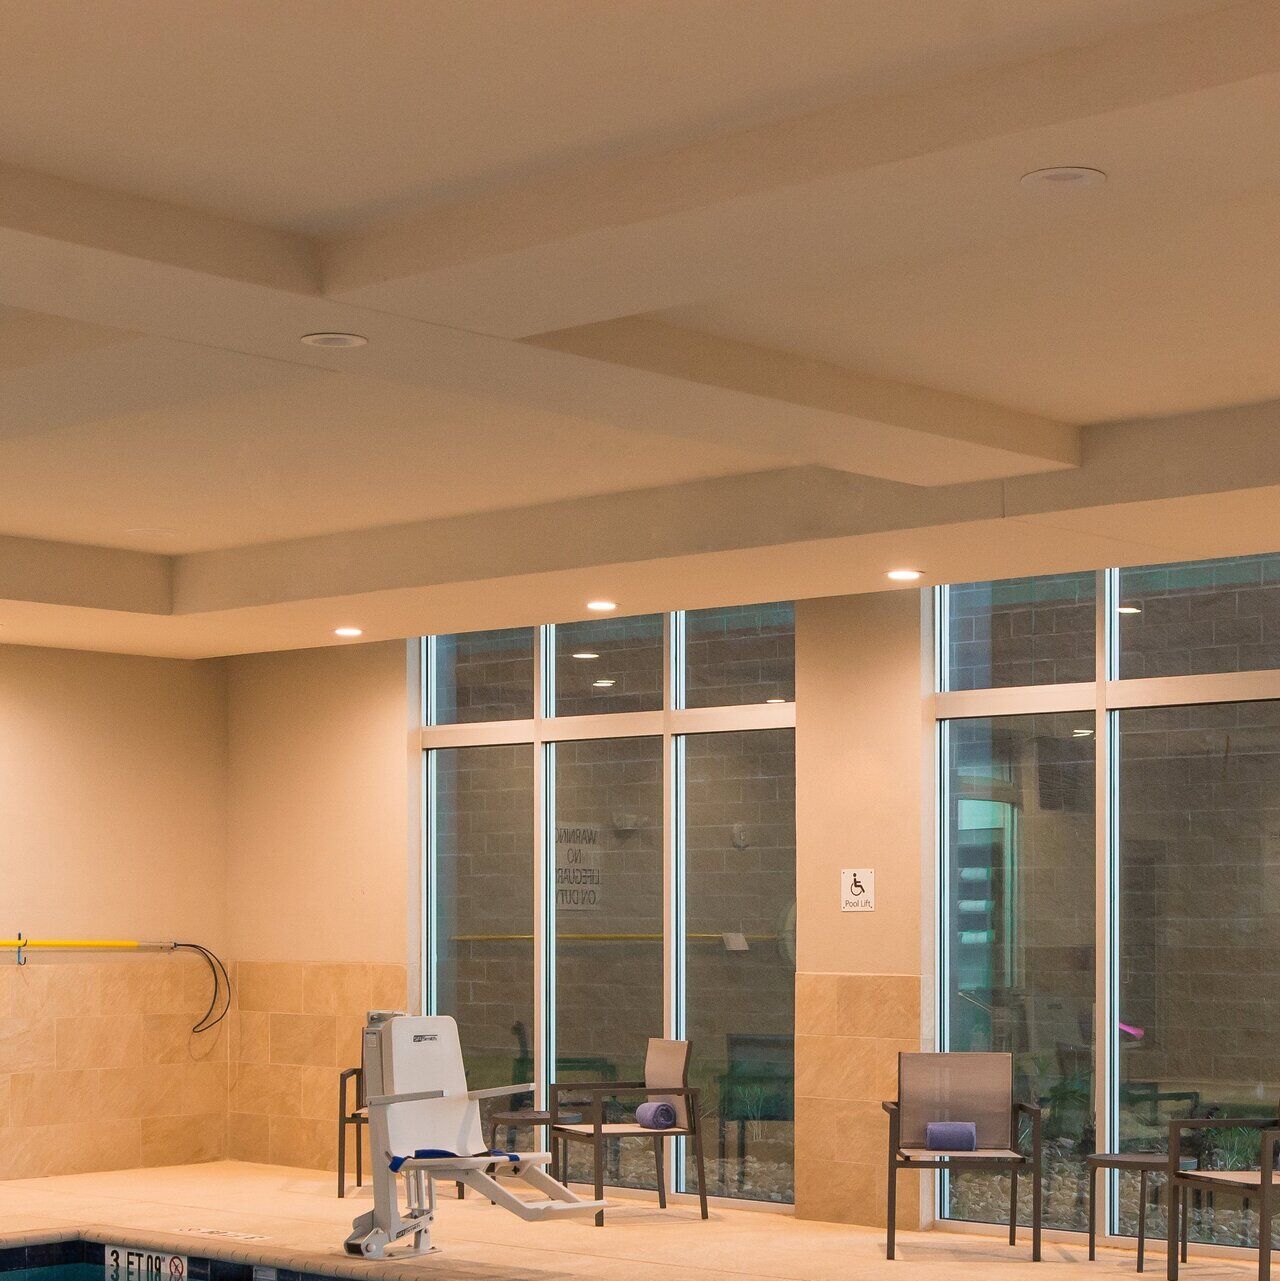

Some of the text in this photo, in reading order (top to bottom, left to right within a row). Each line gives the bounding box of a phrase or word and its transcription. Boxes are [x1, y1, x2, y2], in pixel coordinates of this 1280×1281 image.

[845, 899, 871, 908] Pool Lift
[110, 1249, 119, 1267] 3
